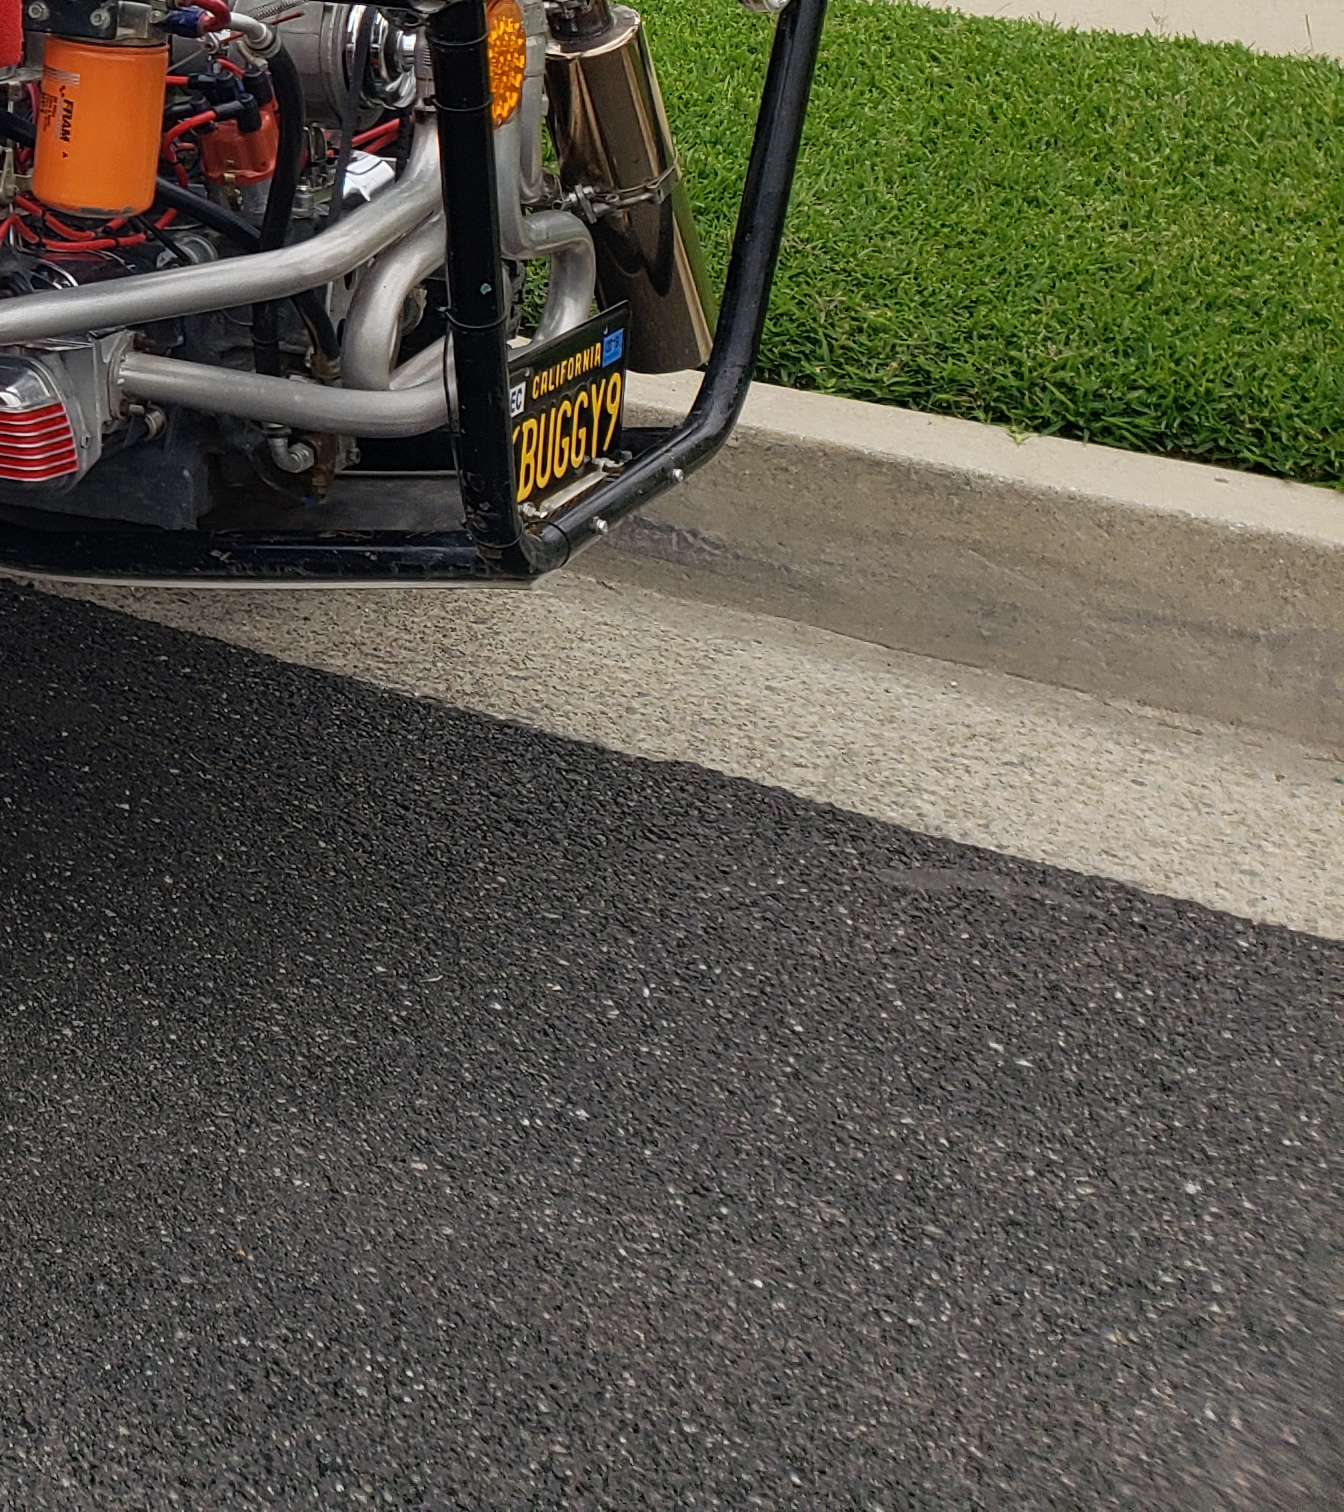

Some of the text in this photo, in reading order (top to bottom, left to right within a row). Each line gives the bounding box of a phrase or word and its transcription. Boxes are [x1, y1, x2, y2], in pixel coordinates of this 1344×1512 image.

[60, 98, 74, 143] FRAM
[531, 342, 602, 400] CALIFORNIA
[511, 387, 523, 414] EC
[512, 372, 622, 503] BUGGY9
